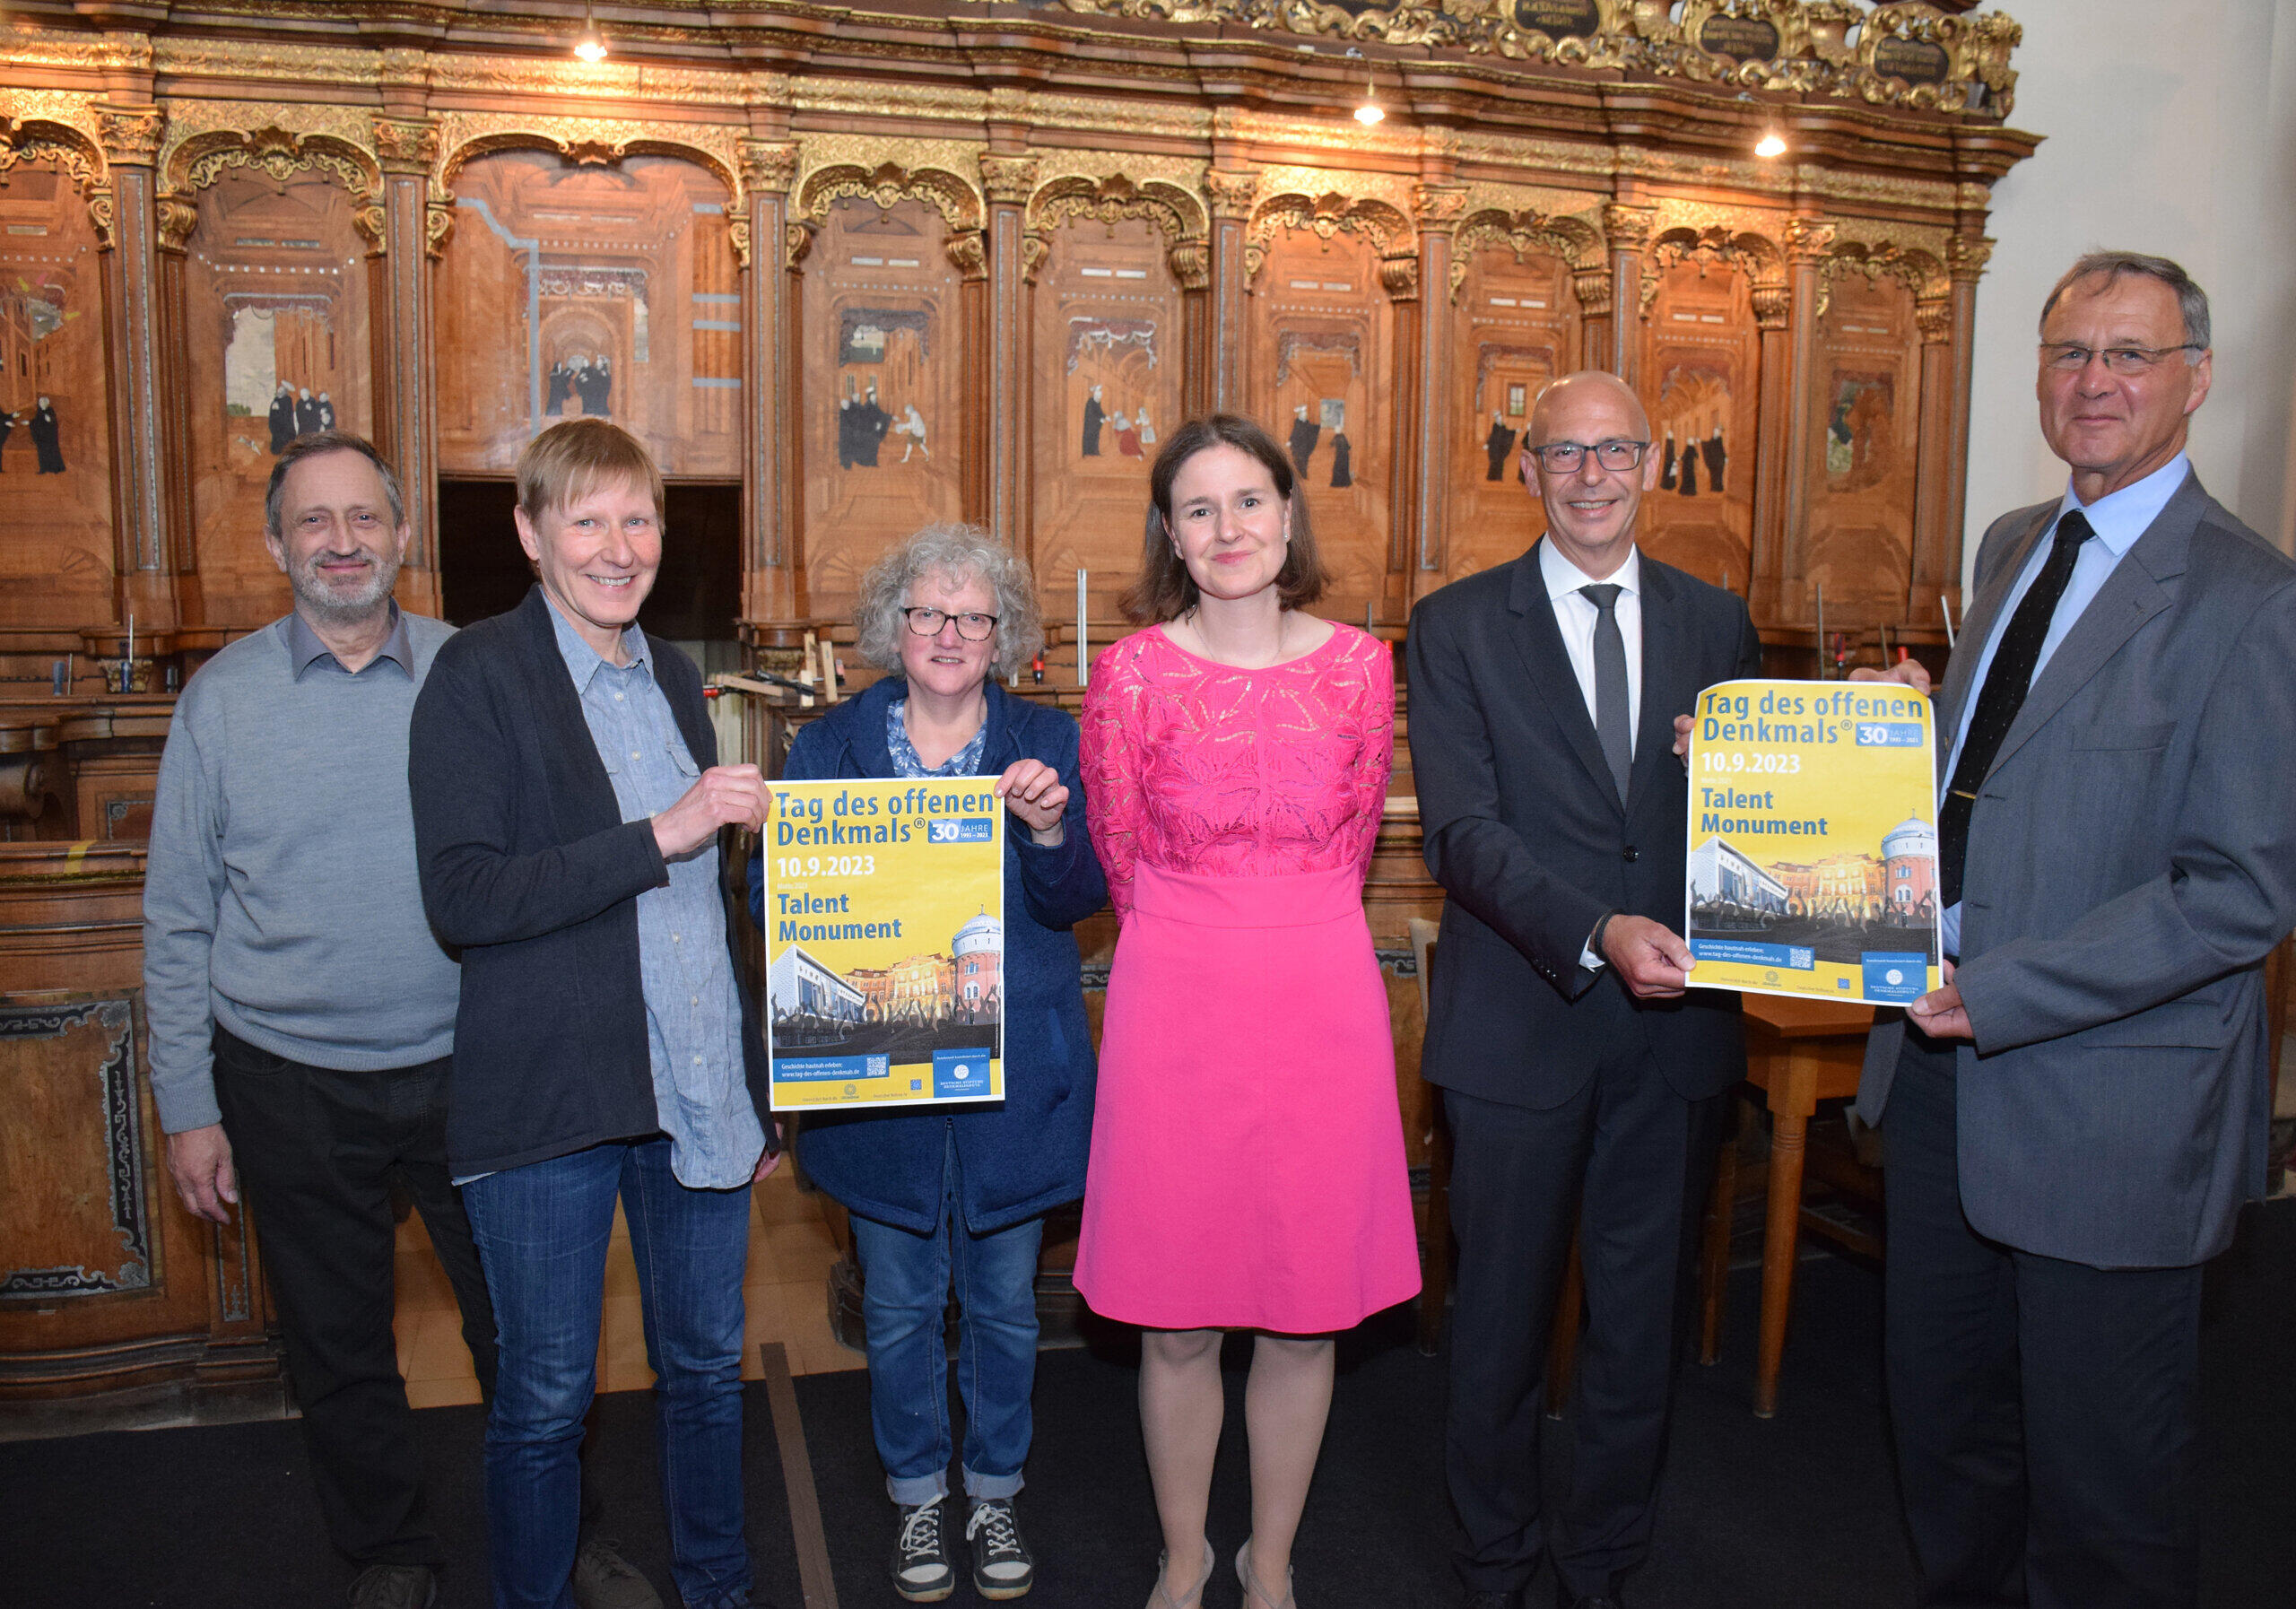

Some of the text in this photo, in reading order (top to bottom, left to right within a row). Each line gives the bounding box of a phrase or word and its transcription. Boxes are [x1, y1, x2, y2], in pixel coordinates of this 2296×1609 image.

[1705, 690, 1923, 720] Tag des offenen
[1859, 726, 1888, 744] 30
[1700, 752, 1801, 774] 10.9.2023
[775, 788, 994, 823] Tag des offenen
[1701, 787, 1774, 809] Talent
[931, 822, 960, 840] 30
[961, 824, 988, 832] JAHRE
[1700, 813, 1828, 835] Monument
[777, 855, 875, 877] 10.9.2023
[778, 892, 849, 914] Talent
[778, 918, 902, 941] Monument
